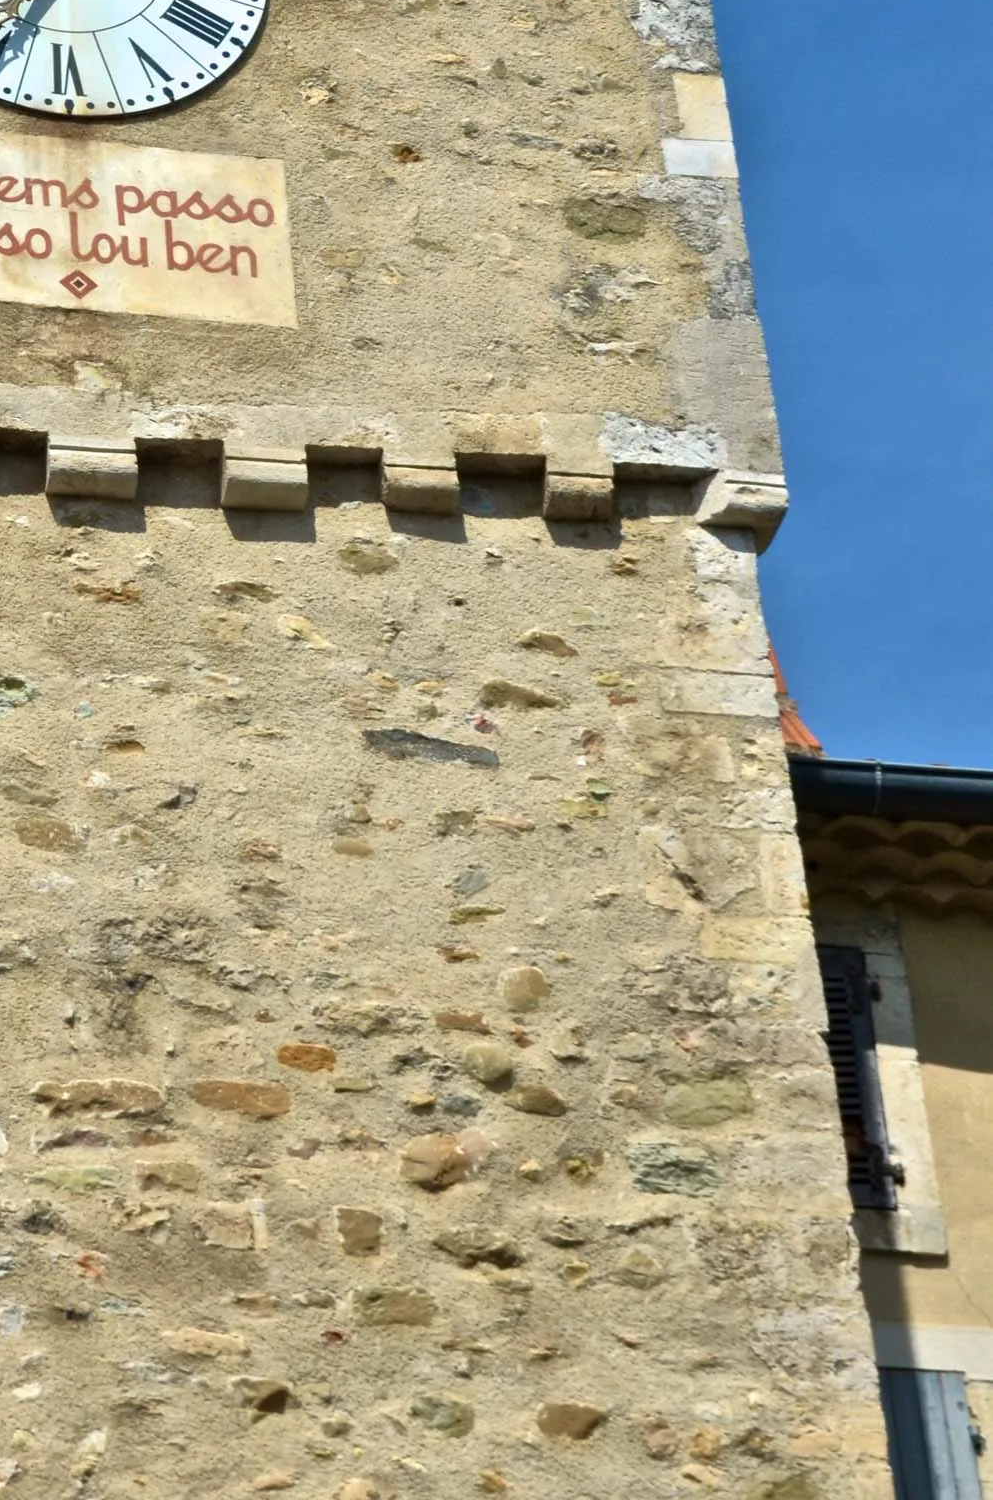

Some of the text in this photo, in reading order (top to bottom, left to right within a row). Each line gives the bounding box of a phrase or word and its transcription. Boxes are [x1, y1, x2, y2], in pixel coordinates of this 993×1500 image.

[49, 42, 88, 97] VI
[127, 36, 175, 89] V
[115, 184, 276, 228] passo
[69, 211, 149, 268] lou
[164, 219, 258, 278] ben
